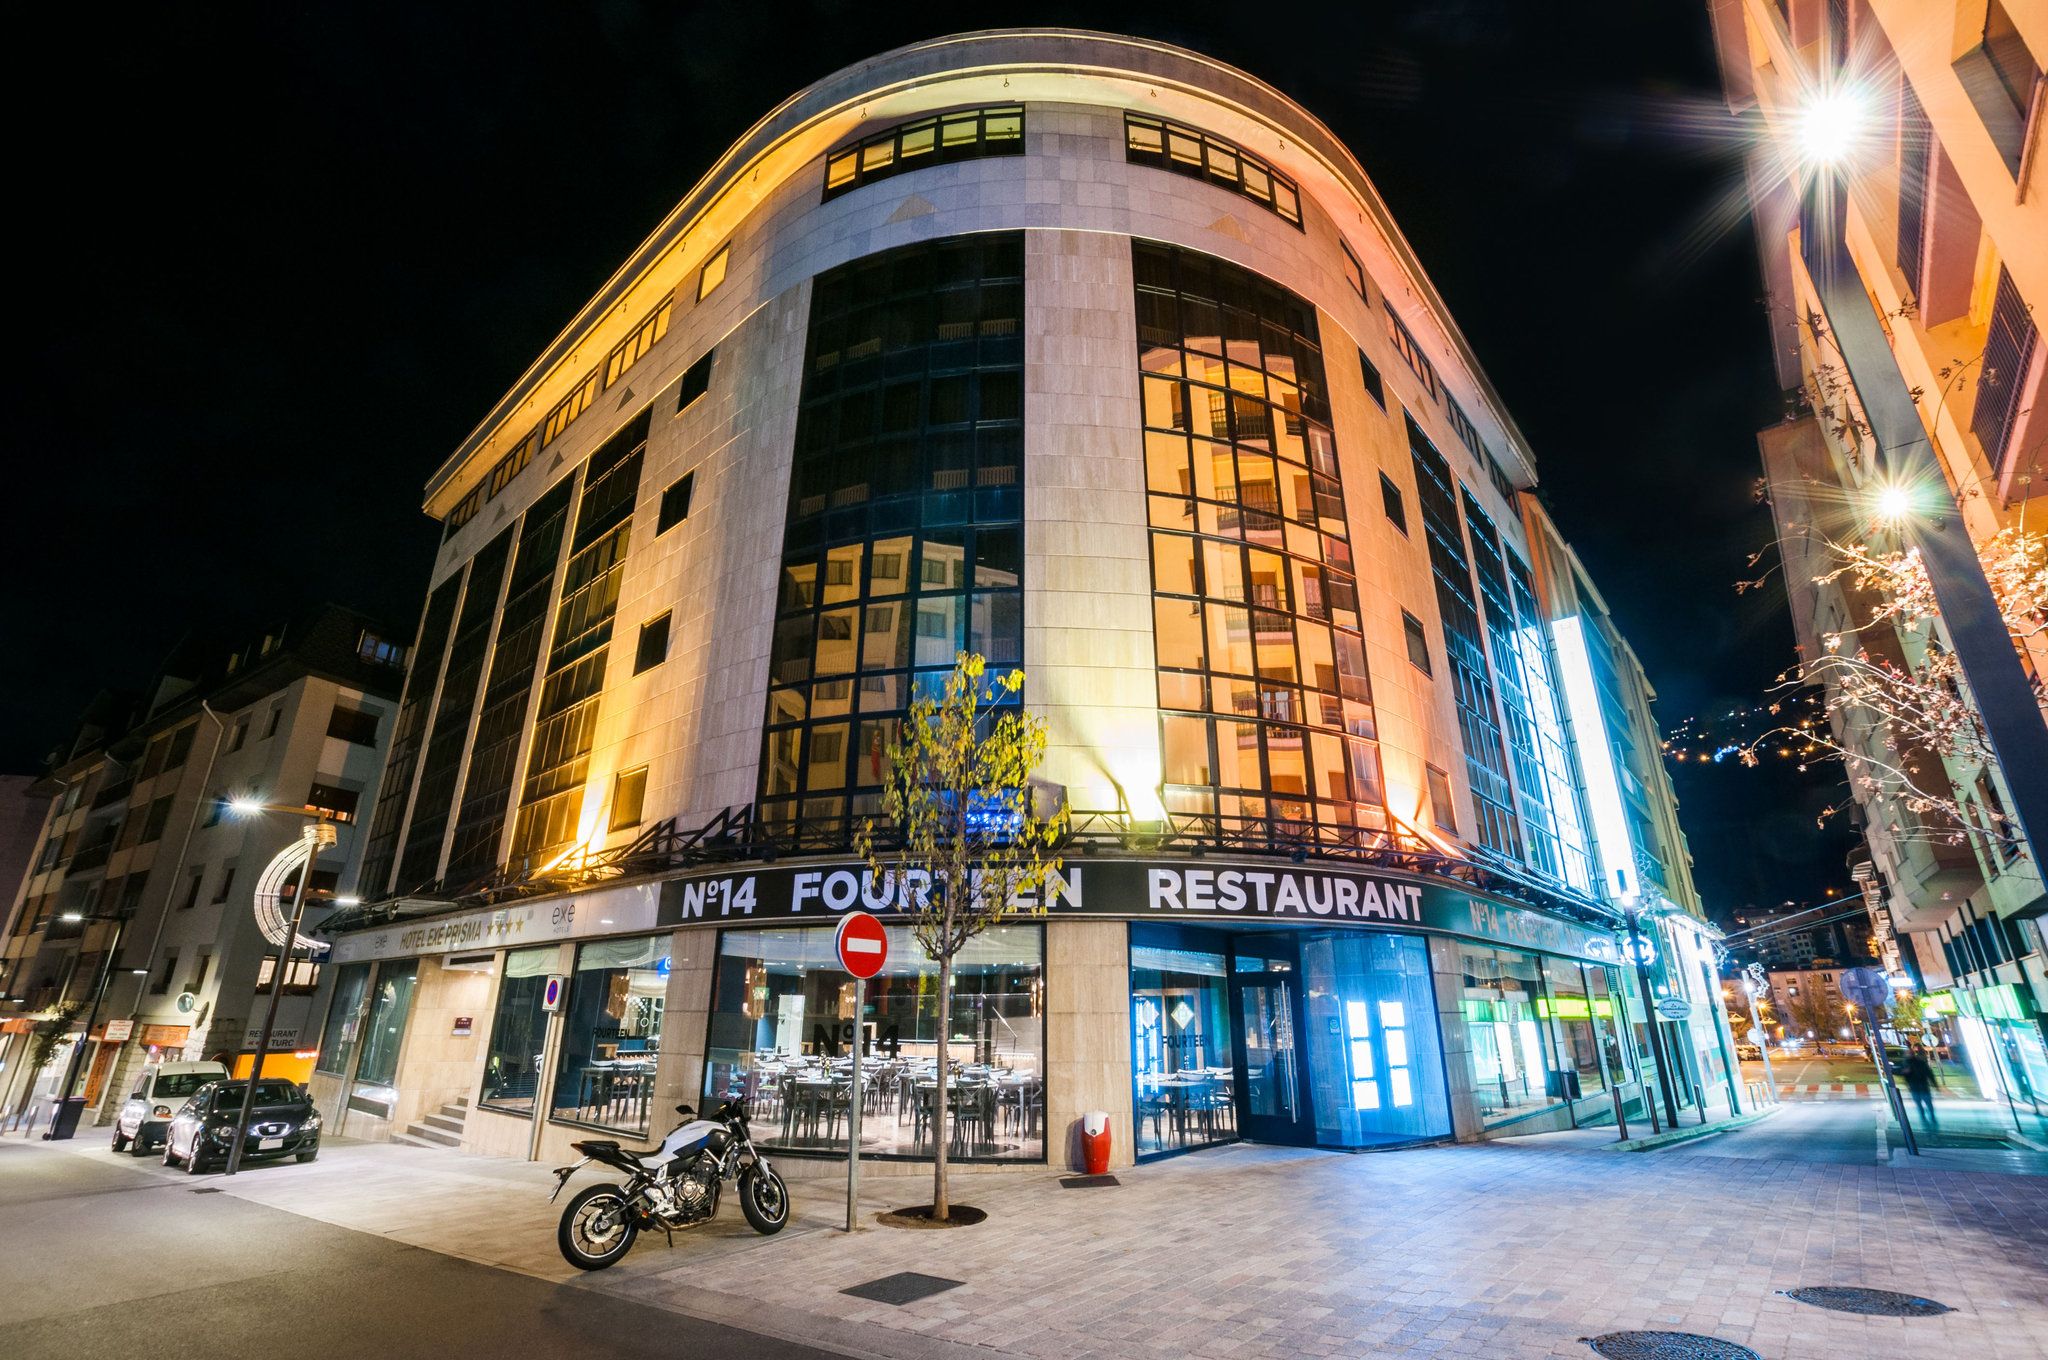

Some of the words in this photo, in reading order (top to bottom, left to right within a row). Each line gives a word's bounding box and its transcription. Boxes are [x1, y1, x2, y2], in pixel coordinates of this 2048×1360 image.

[1148, 868, 1422, 922] RESTAURANT
[552, 904, 576, 925] exe
[400, 930, 426, 950] HOTEL
[427, 927, 444, 946] EXE
[445, 920, 482, 945] PRISMA
[248, 1030, 298, 1038] RESURANT
[593, 1027, 630, 1038] FOURTEEN
[271, 1039, 294, 1047] TURC
[1161, 1034, 1211, 1049] FOURTEEN
